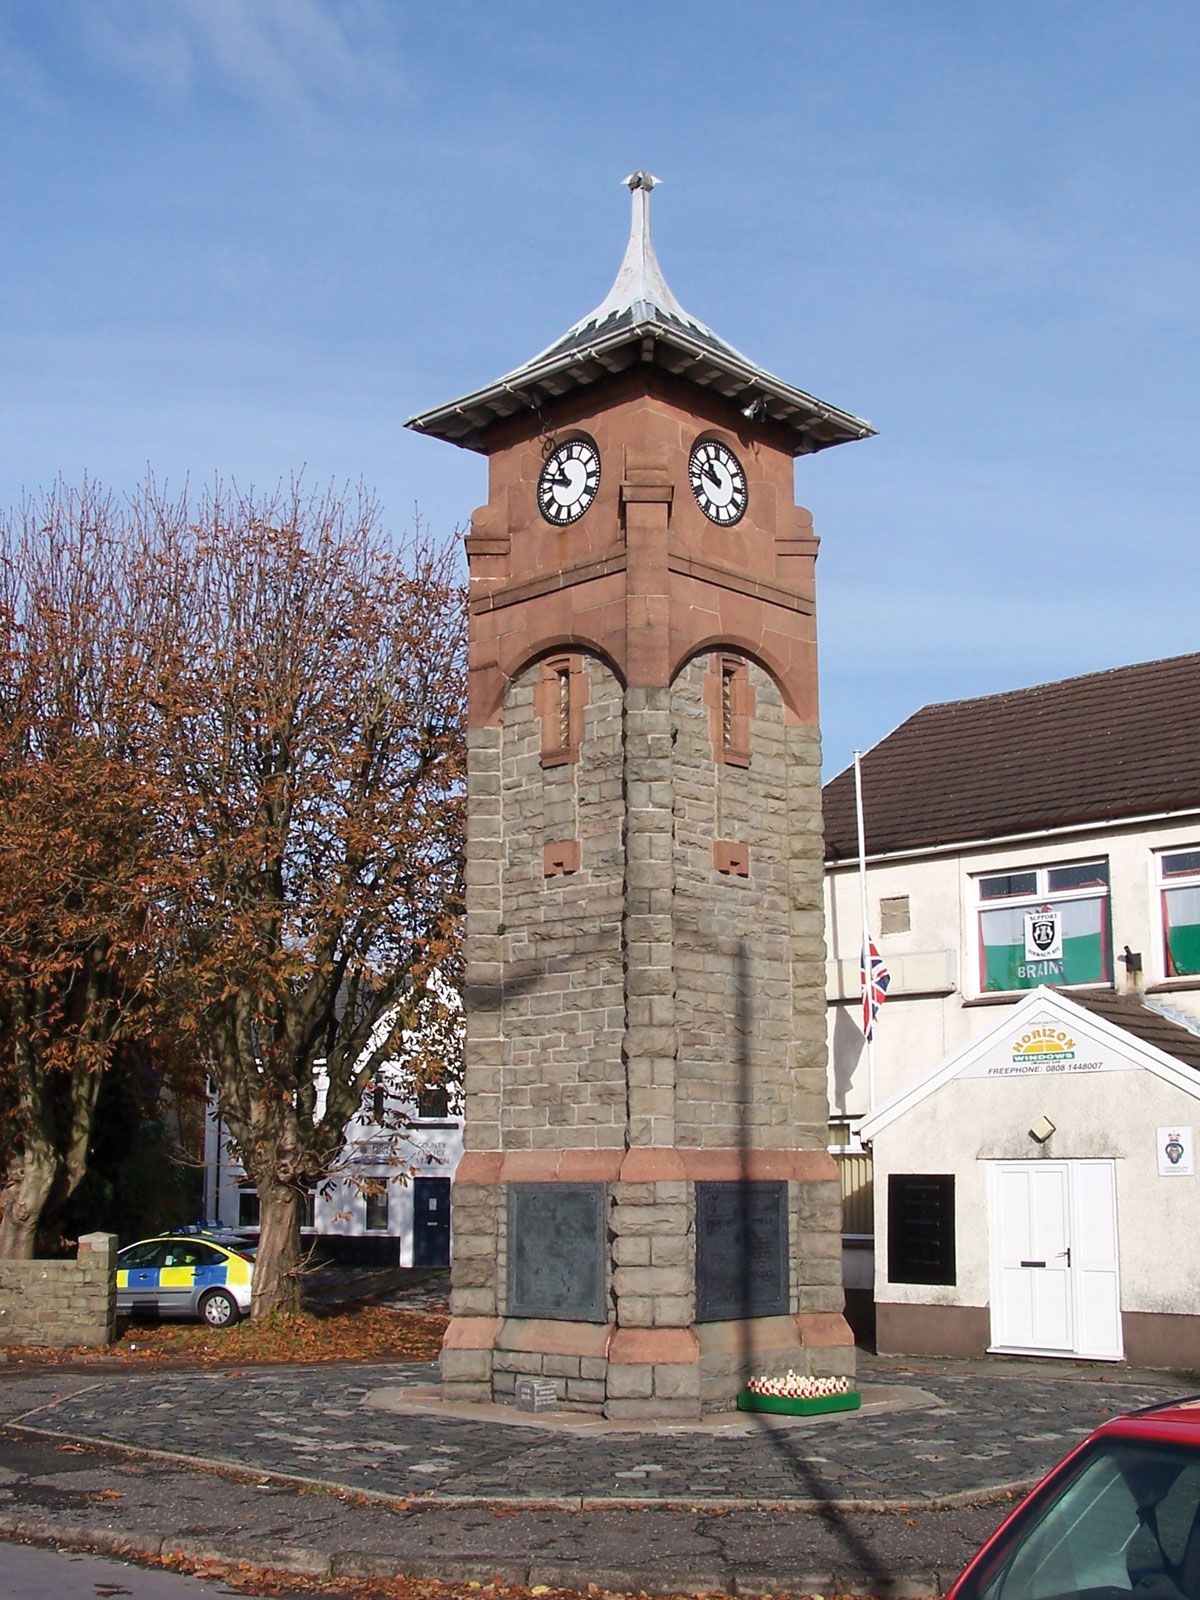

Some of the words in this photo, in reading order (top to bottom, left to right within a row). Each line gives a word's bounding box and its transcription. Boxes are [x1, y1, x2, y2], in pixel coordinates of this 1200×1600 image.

[1029, 913, 1058, 921] SUPPORT
[1017, 960, 1064, 978] BRAINS
[1012, 1028, 1077, 1053] HORIZON
[1013, 1052, 1074, 1062] WINDOWS
[988, 1066, 1043, 1075] FREEPHONE:
[1045, 1064, 1066, 1073] 0808
[415, 1157, 450, 1165] STON
